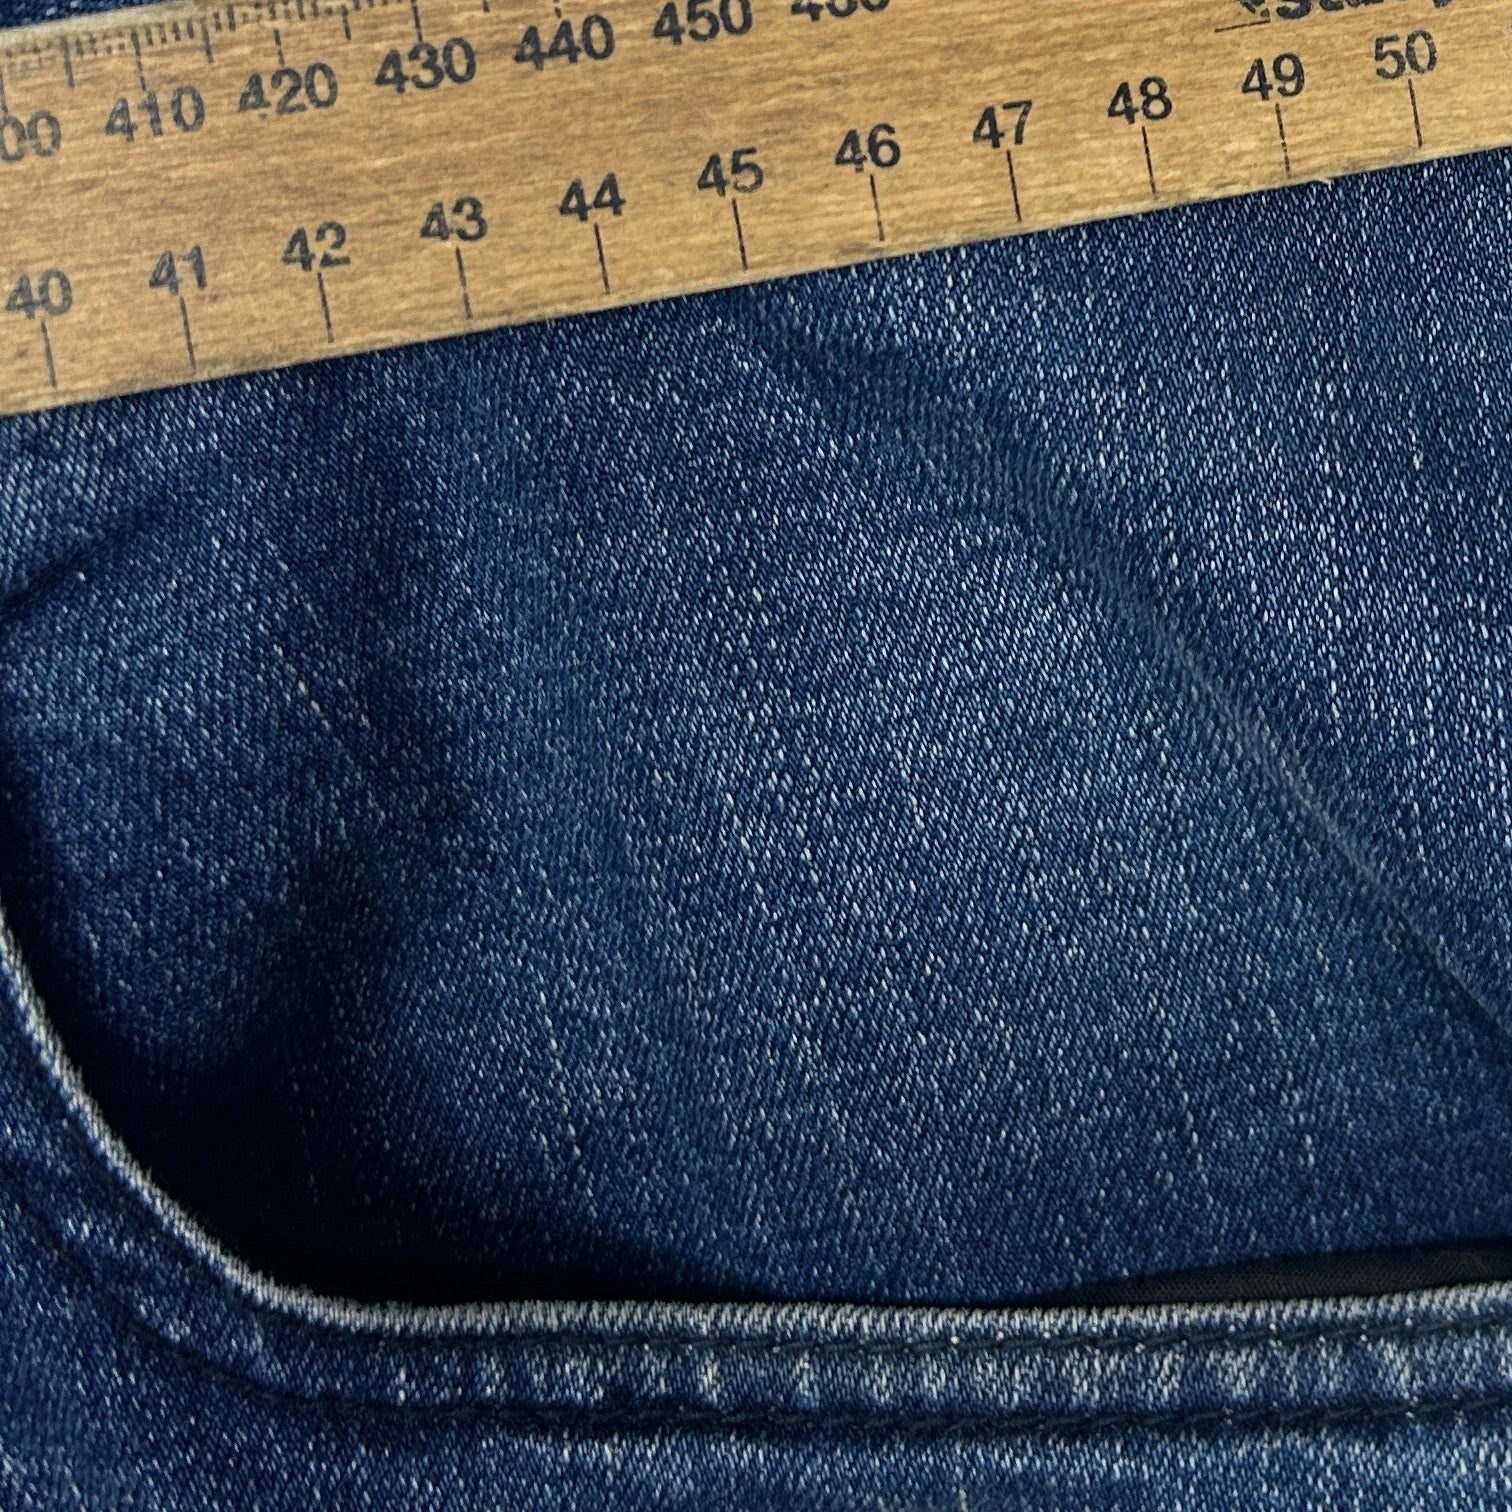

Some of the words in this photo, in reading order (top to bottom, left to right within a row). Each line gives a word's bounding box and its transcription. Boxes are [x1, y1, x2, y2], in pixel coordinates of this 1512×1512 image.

[0, 110, 61, 162] 00
[106, 87, 205, 142] 410
[239, 63, 338, 117] 420
[376, 38, 477, 93] 430
[515, 15, 615, 70] 440
[5, 269, 73, 320] 40
[150, 244, 207, 294] 41
[282, 221, 350, 272] 42
[420, 197, 488, 241] 43
[558, 173, 625, 222] 44
[697, 147, 764, 198] 45
[835, 123, 900, 173] 46
[973, 100, 1033, 149] 47
[1108, 76, 1173, 125] 48
[1241, 52, 1305, 102] 49
[1374, 30, 1437, 80] 50
